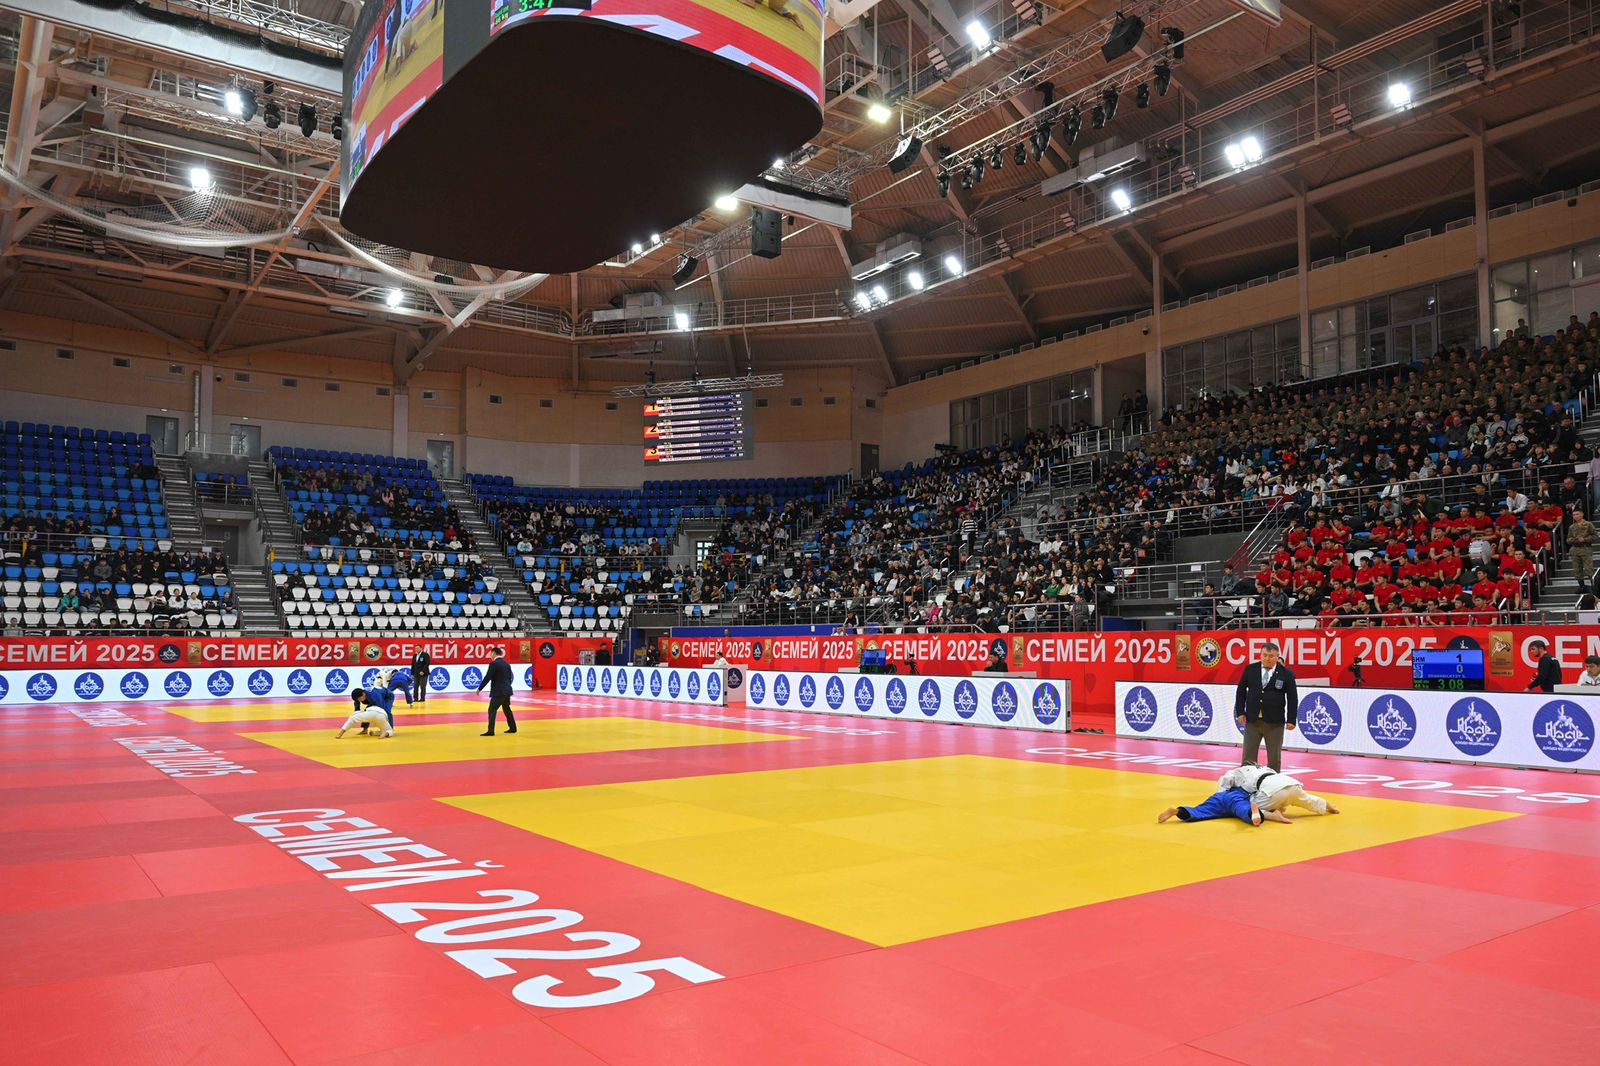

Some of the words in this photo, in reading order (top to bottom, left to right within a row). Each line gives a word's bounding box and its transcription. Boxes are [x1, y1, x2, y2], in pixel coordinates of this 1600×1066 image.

[0, 640, 87, 663] ЕМЕЙ
[96, 644, 155, 662] 2025
[202, 640, 288, 661] СЕМЕЙ
[295, 644, 345, 660] 2025
[682, 638, 723, 658] СЕМЕЙ
[726, 641, 751, 658] 2025
[772, 637, 819, 660] СЕМЕЙ
[822, 641, 854, 660] 2025
[881, 636, 941, 661] СЕМЕЙ
[946, 639, 989, 661] 2025
[1026, 633, 1106, 663] СЕМЕЙ
[1113, 638, 1171, 664] 2025
[1455, 653, 1463, 663] 1
[1456, 664, 1464, 674] 0
[1313, 773, 1600, 804] 2025
[233, 807, 504, 892] СЕМЕЙ
[370, 888, 726, 1008] 2025
